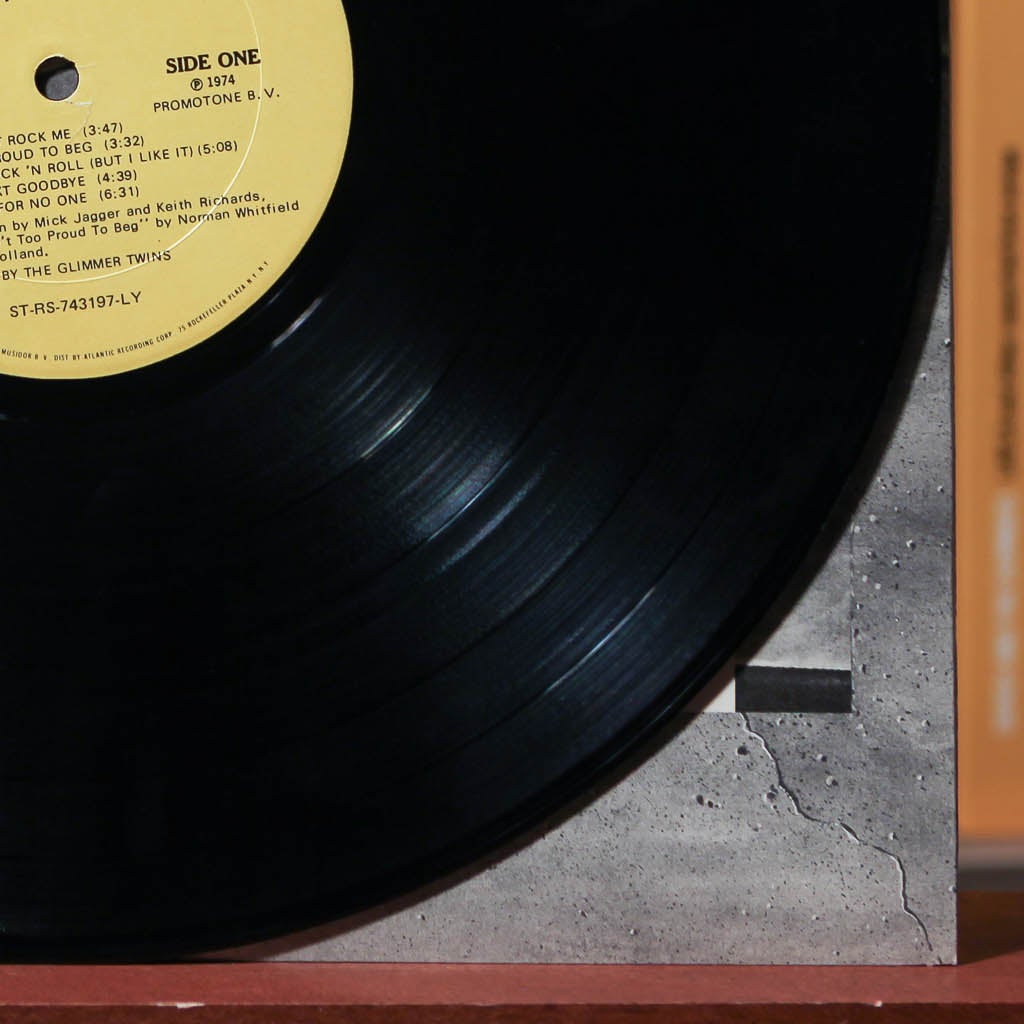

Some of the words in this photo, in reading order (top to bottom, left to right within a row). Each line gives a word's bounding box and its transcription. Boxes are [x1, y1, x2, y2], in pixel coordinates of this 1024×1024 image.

[166, 54, 211, 74] SIDE
[218, 48, 261, 68] ONE
[207, 74, 235, 87] 1974
[153, 91, 242, 112] PROMOTONE
[7, 131, 46, 146] ROCK
[52, 129, 71, 142] ME
[83, 122, 123, 137] (3:47)
[40, 146, 58, 157] TO
[65, 142, 92, 155] BEG
[104, 136, 144, 151] (3:32)
[26, 165, 41, 176] 'N
[48, 160, 84, 173] ROLL
[90, 155, 122, 169] (BUT
[129, 153, 133, 163] I
[140, 149, 170, 162] LIKE
[176, 146, 193, 158] IT)
[198, 141, 238, 156] (5:08)
[17, 176, 85, 194] GOODBYE
[97, 170, 137, 185] (4:39)
[30, 196, 50, 209] NO
[57, 193, 87, 206] ONE
[99, 186, 139, 201] (6:31)
[13, 220, 28, 233] by
[34, 212, 67, 227] Mick
[74, 210, 120, 224] Jagger
[127, 204, 150, 216] and
[157, 200, 192, 213] Keith
[199, 192, 265, 208] Richards,
[17, 234, 41, 245] Too
[47, 227, 86, 241] Proud
[94, 225, 108, 235] To
[156, 218, 172, 229] by
[178, 208, 230, 224] Norman
[235, 201, 300, 218] Whitfield
[2, 269, 17, 280] BY
[24, 265, 51, 278] THE
[57, 256, 121, 274] GLIMMER
[127, 250, 172, 265] TWINS
[10, 291, 142, 317] ST-RS-743197-LY
[84, 351, 114, 359] ATLANTIC
[117, 339, 154, 354] RECORDING
[187, 299, 227, 327] ROCKEFELLER
[228, 284, 246, 300] PLAZA
